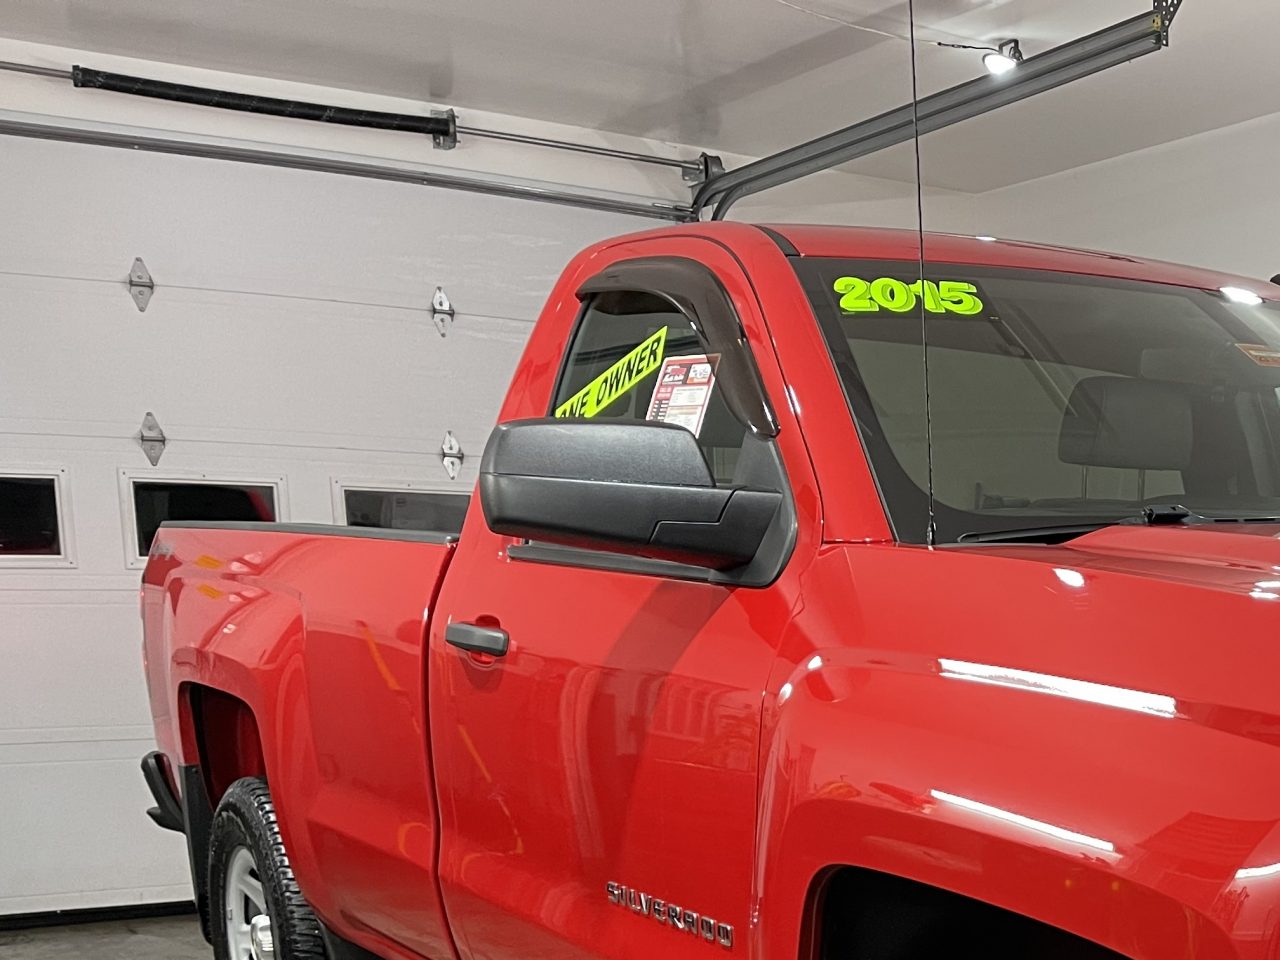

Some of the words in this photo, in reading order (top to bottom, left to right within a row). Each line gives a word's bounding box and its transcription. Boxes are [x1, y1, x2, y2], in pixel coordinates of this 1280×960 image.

[833, 276, 984, 315] 2015
[596, 336, 662, 407] OWNER
[606, 881, 734, 947] SILVERADO
